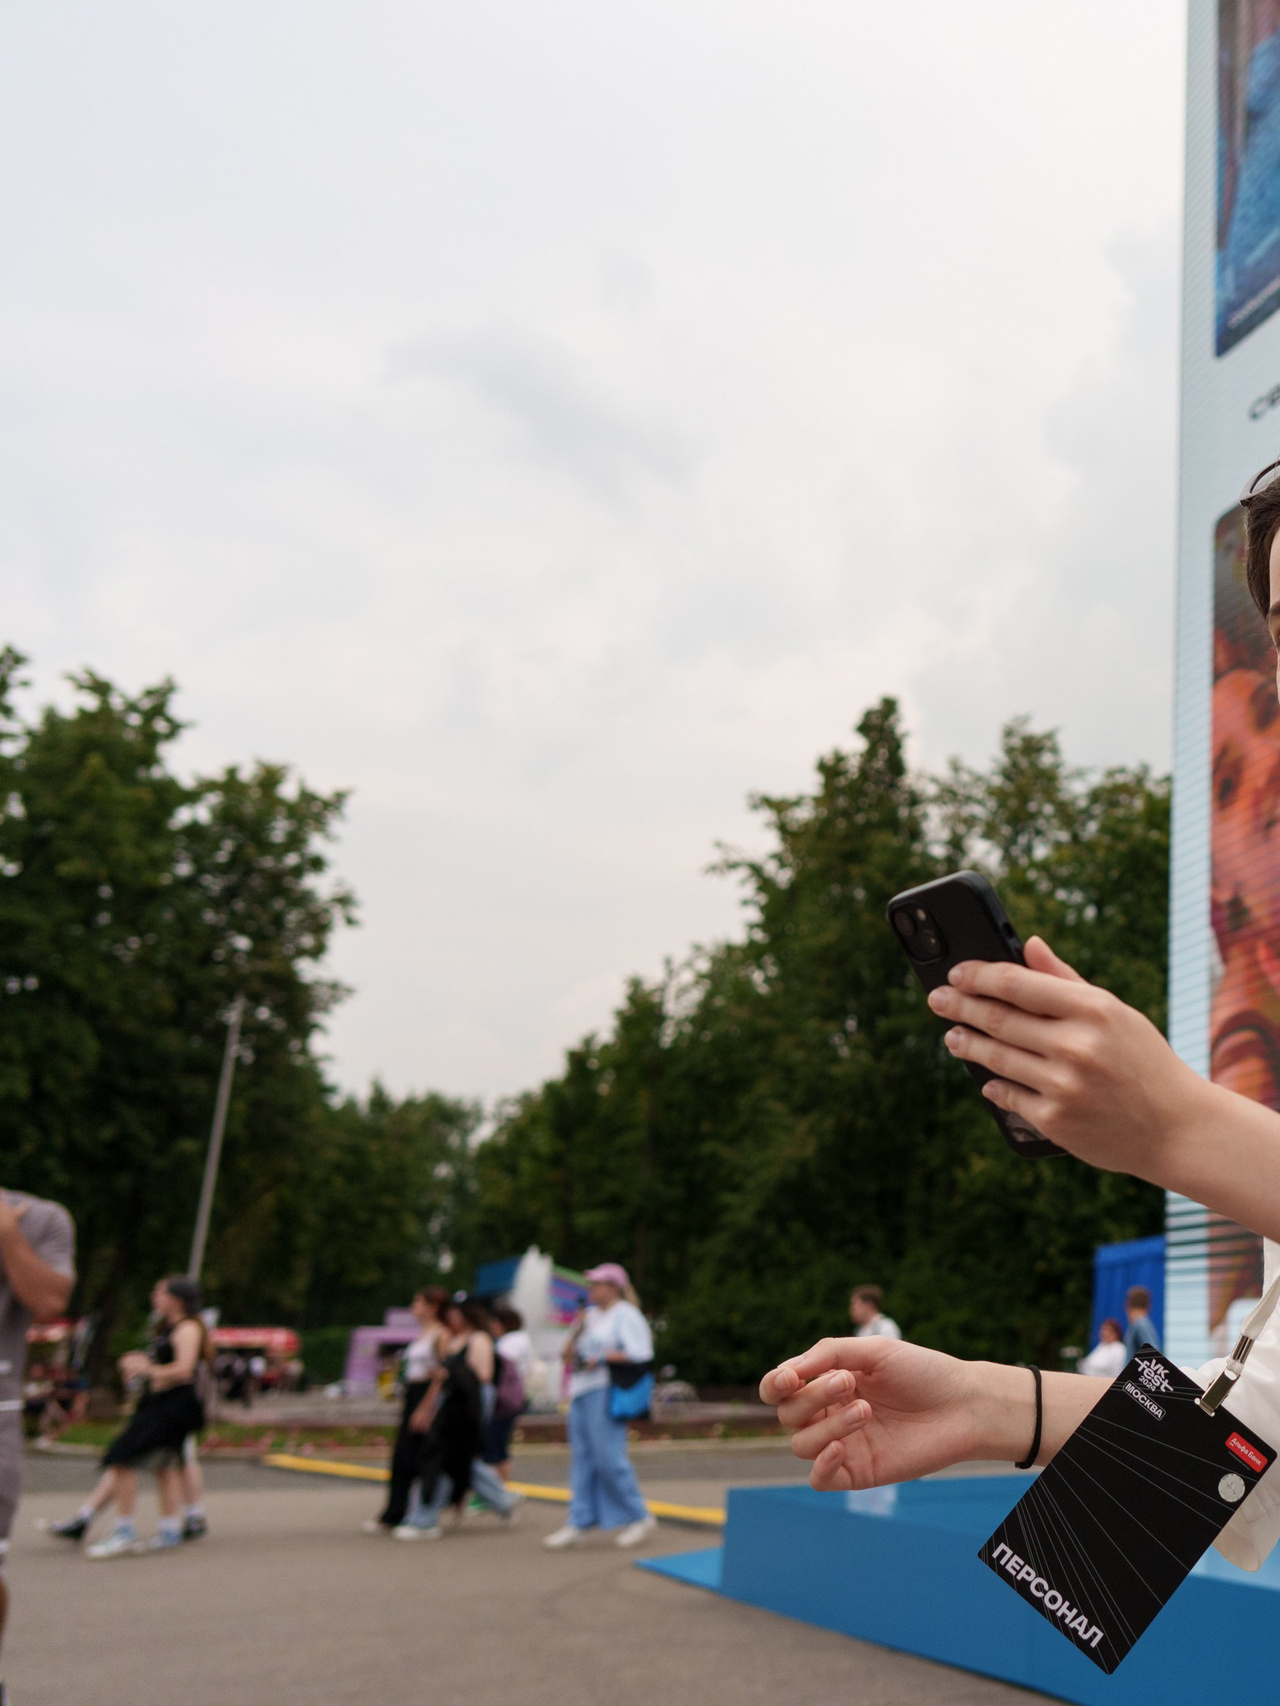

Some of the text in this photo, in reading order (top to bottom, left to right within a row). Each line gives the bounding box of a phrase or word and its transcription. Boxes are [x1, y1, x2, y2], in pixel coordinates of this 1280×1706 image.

[1134, 1356, 1174, 1393] fest
[1138, 1375, 1157, 1392] 2024
[1150, 1358, 1170, 1380] VK
[1124, 1382, 1163, 1419] МОСКВА
[1229, 1437, 1250, 1456] Альфа
[1247, 1450, 1262, 1467] Банк
[991, 1541, 1104, 1648] ПЕРСОНАЛ
